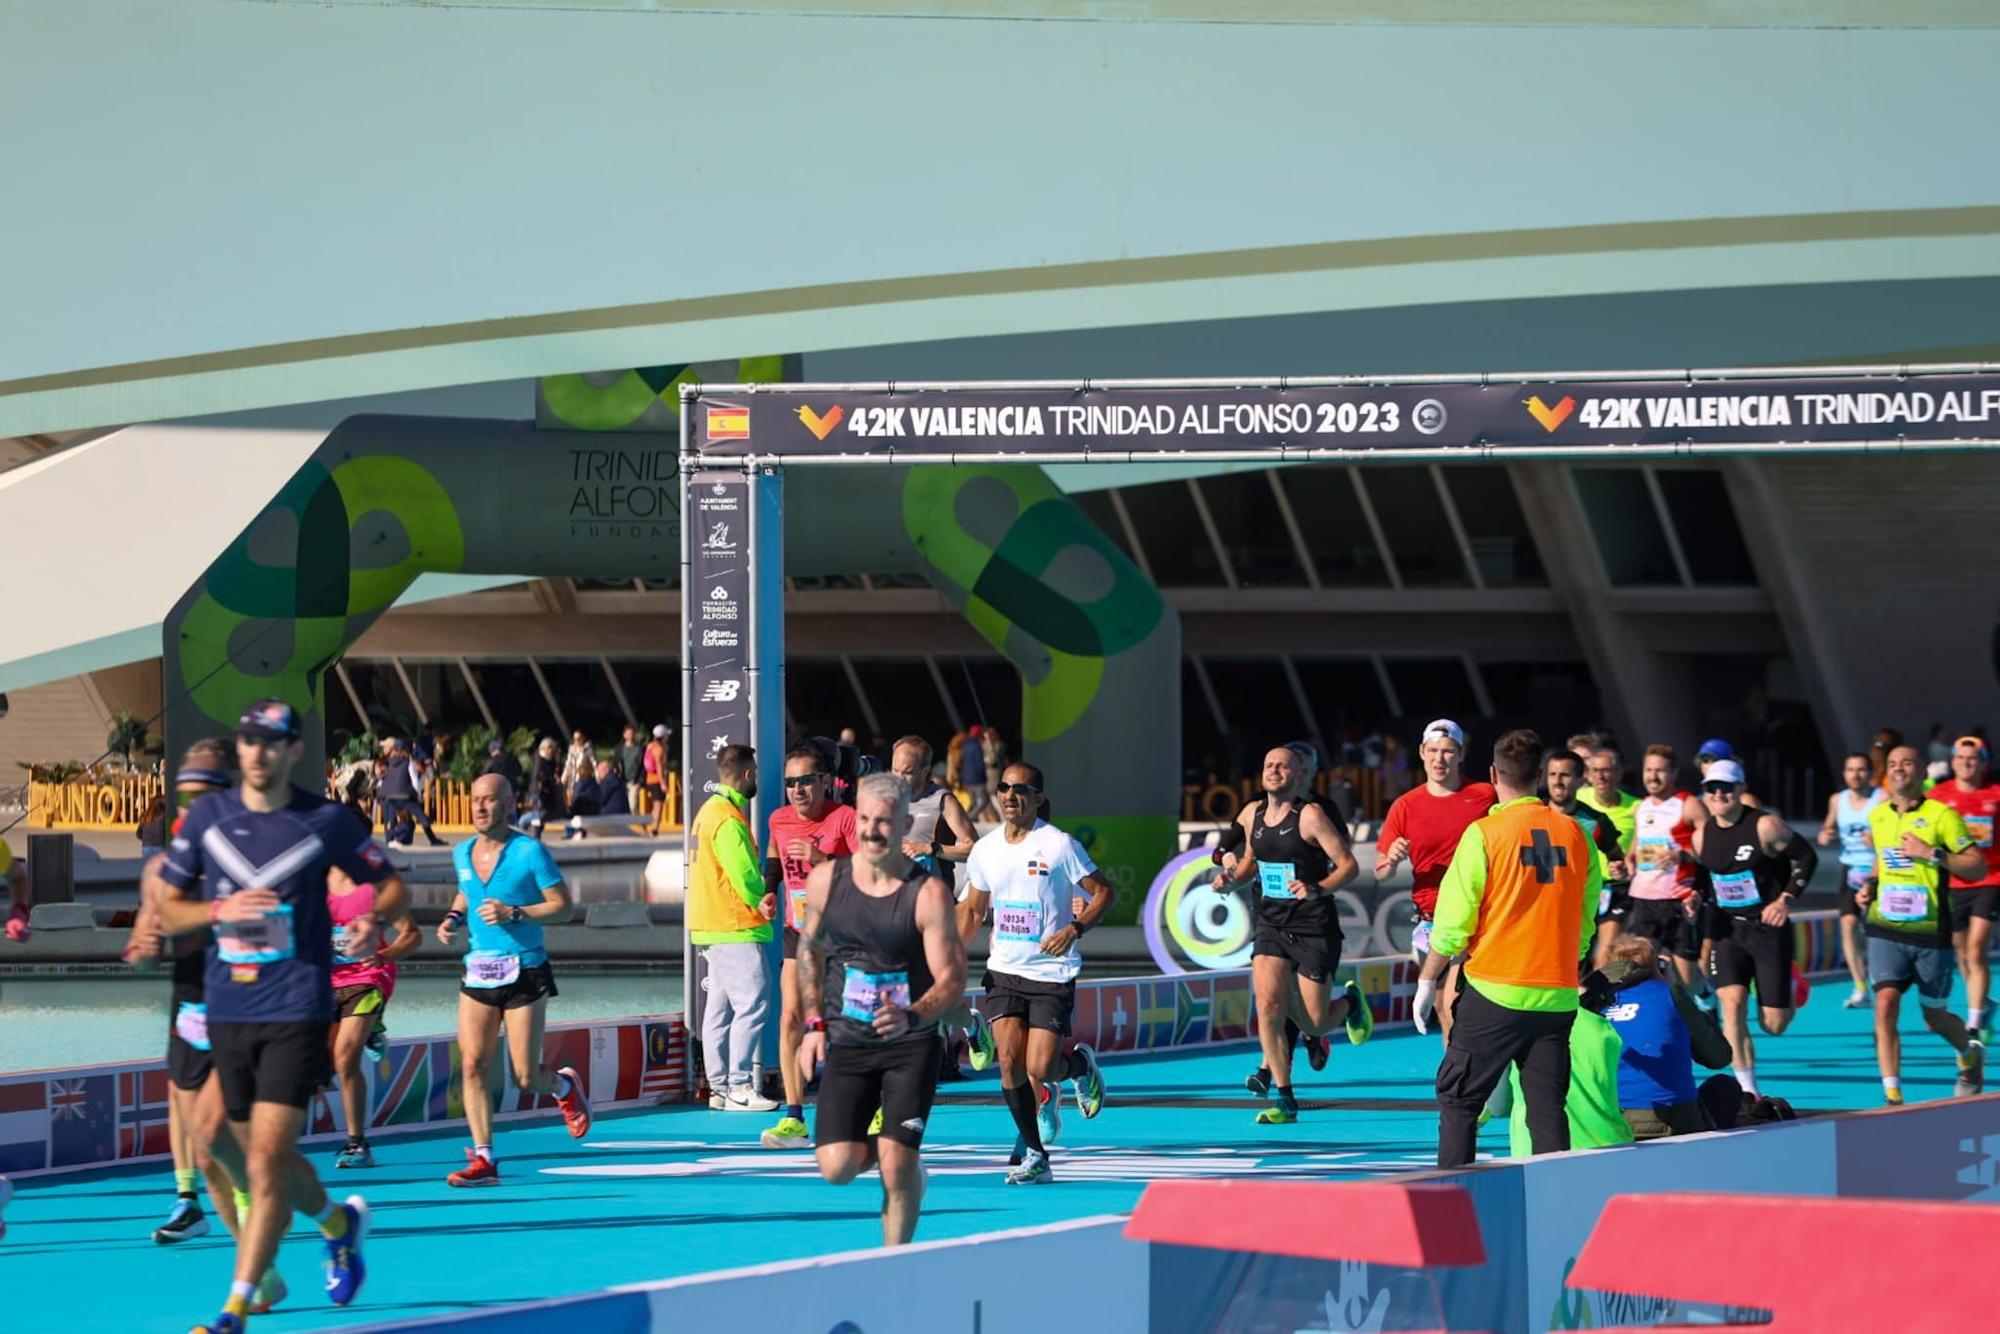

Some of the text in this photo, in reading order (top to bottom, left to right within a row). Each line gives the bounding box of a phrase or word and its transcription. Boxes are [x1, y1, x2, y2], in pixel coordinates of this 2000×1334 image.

[848, 401, 1400, 437] 42K VALENCIA TRINIDAD ALFONSO 2023
[1579, 389, 2000, 429] 42K VALENCIA TRINIDAD ALF
[570, 449, 680, 482] TRINID
[569, 485, 680, 517] ALFON
[571, 525, 680, 538] FUNDAC
